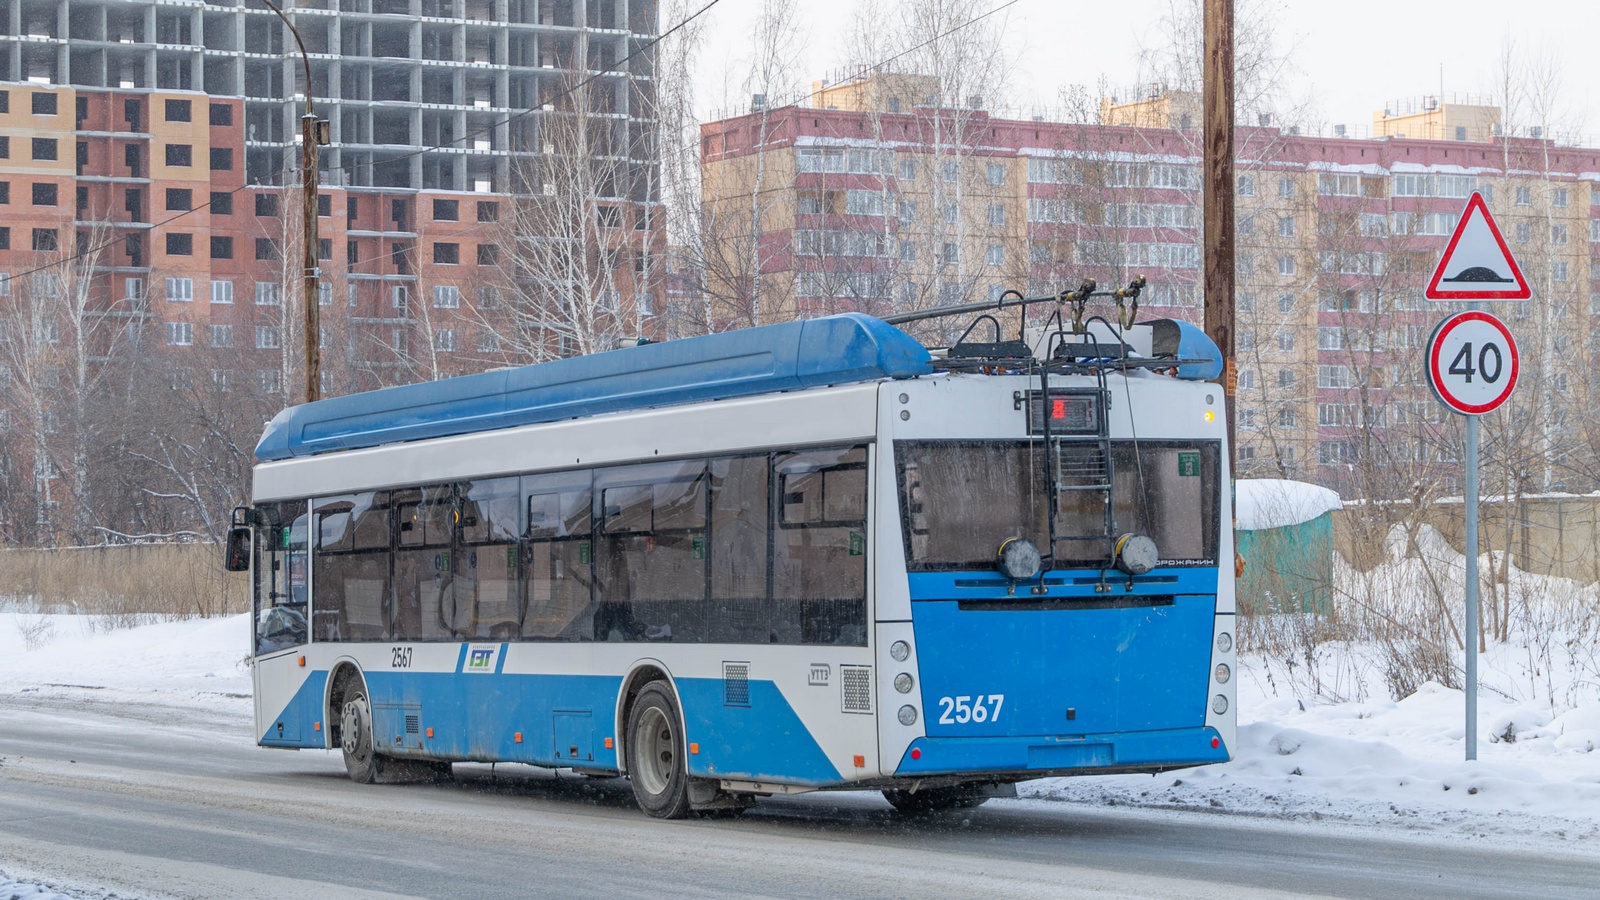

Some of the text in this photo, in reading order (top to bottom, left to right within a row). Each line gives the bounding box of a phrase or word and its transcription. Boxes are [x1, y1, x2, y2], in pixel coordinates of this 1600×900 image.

[1448, 341, 1503, 384] 40
[391, 646, 413, 668] 2567
[938, 694, 1005, 725] 2567
